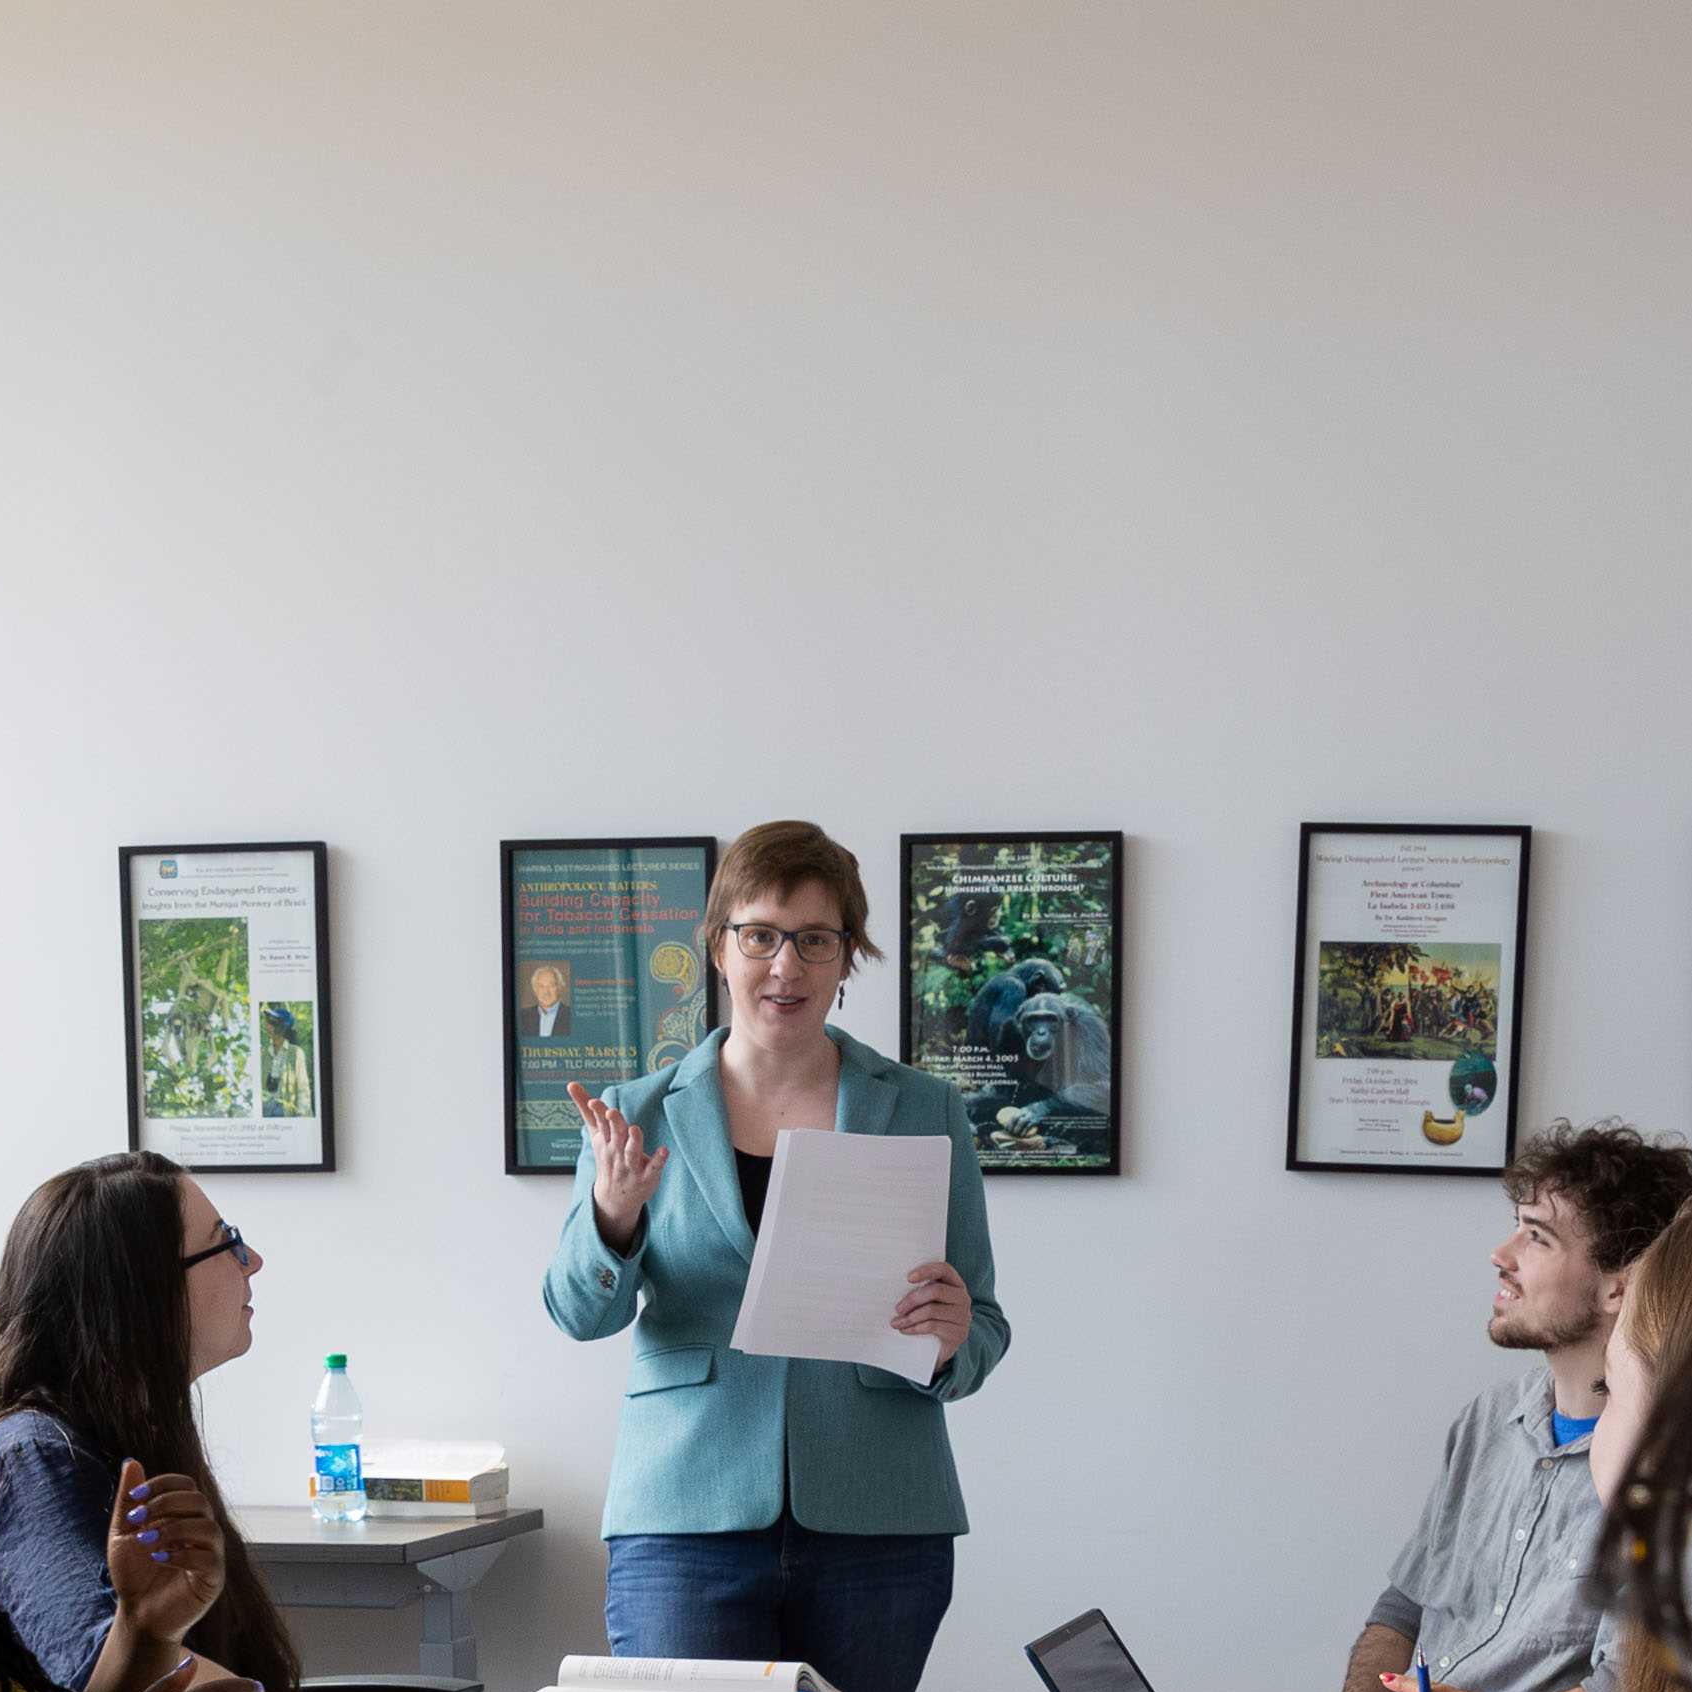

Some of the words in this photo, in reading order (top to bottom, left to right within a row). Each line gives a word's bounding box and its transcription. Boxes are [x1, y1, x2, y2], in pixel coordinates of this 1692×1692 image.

[952, 874, 1025, 884] CHIMPANZEE
[1026, 873, 1078, 883] CULTURE:
[201, 886, 255, 896] Endangered
[519, 894, 584, 908] Building
[590, 892, 660, 908] Capacity
[519, 910, 540, 921] for
[546, 909, 614, 921] Tobacco
[619, 908, 699, 921] Cessation
[568, 925, 591, 935] and
